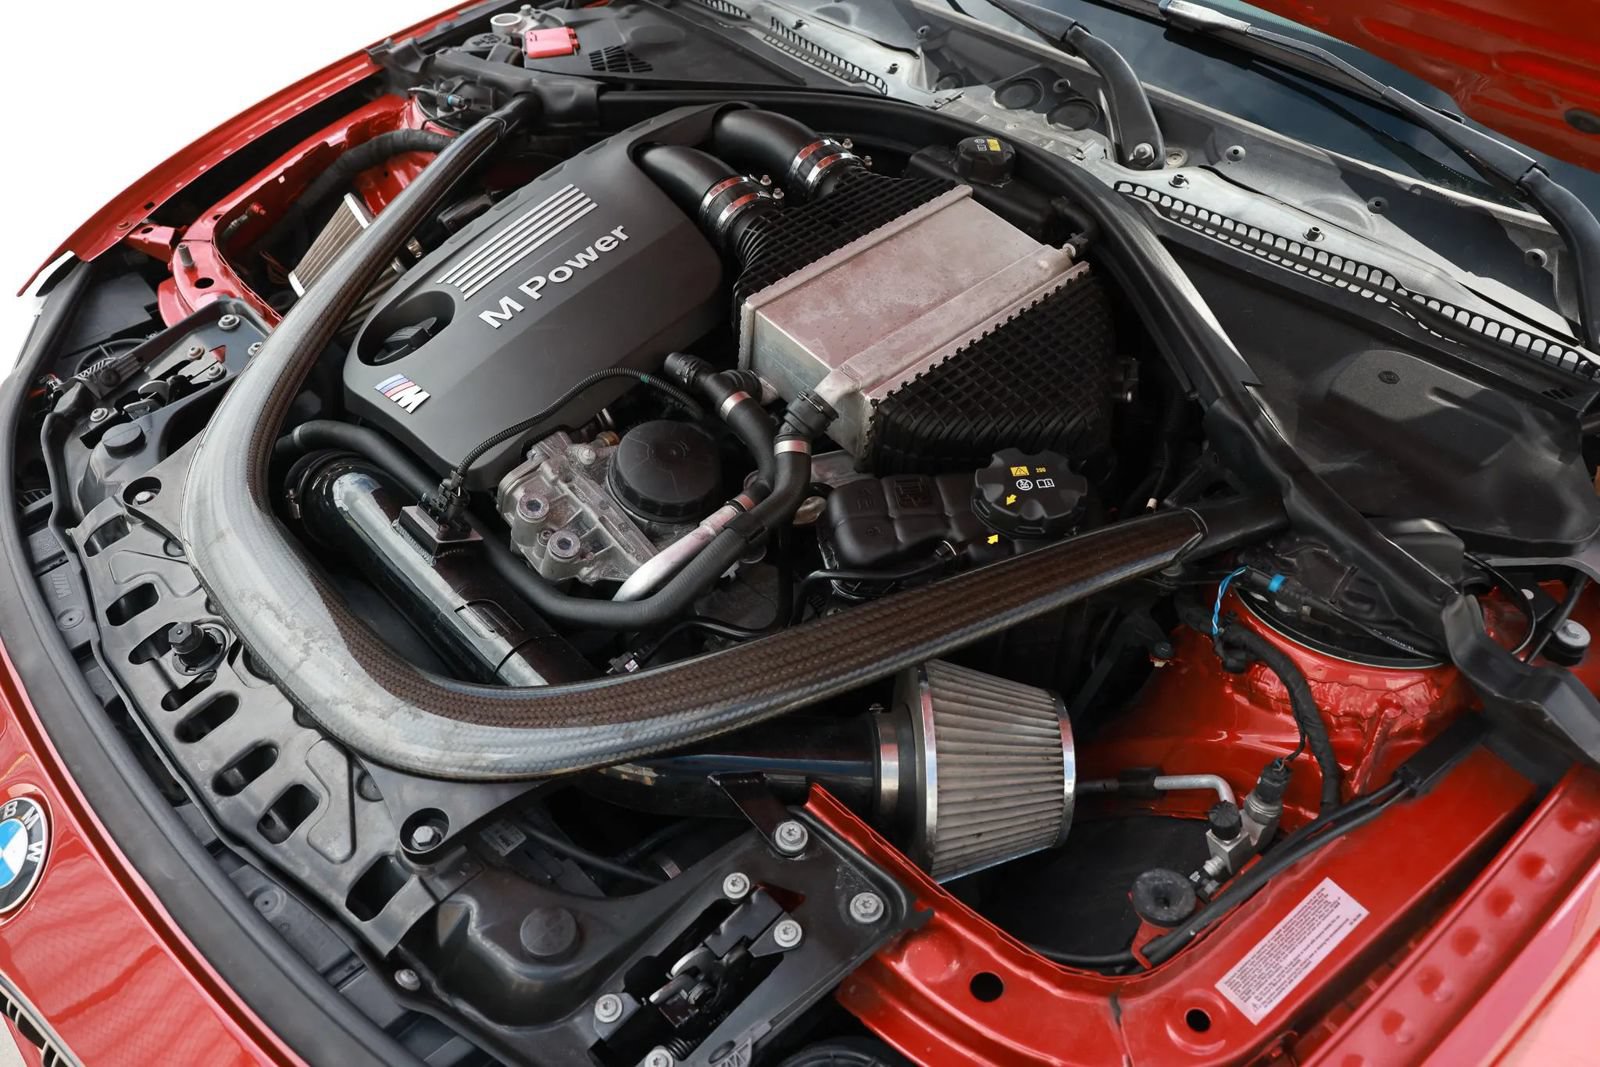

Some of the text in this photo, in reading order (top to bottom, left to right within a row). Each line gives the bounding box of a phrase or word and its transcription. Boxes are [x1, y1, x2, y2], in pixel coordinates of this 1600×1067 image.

[478, 225, 630, 329] M Power
[388, 385, 431, 414] M
[2, 801, 43, 862] BMW
